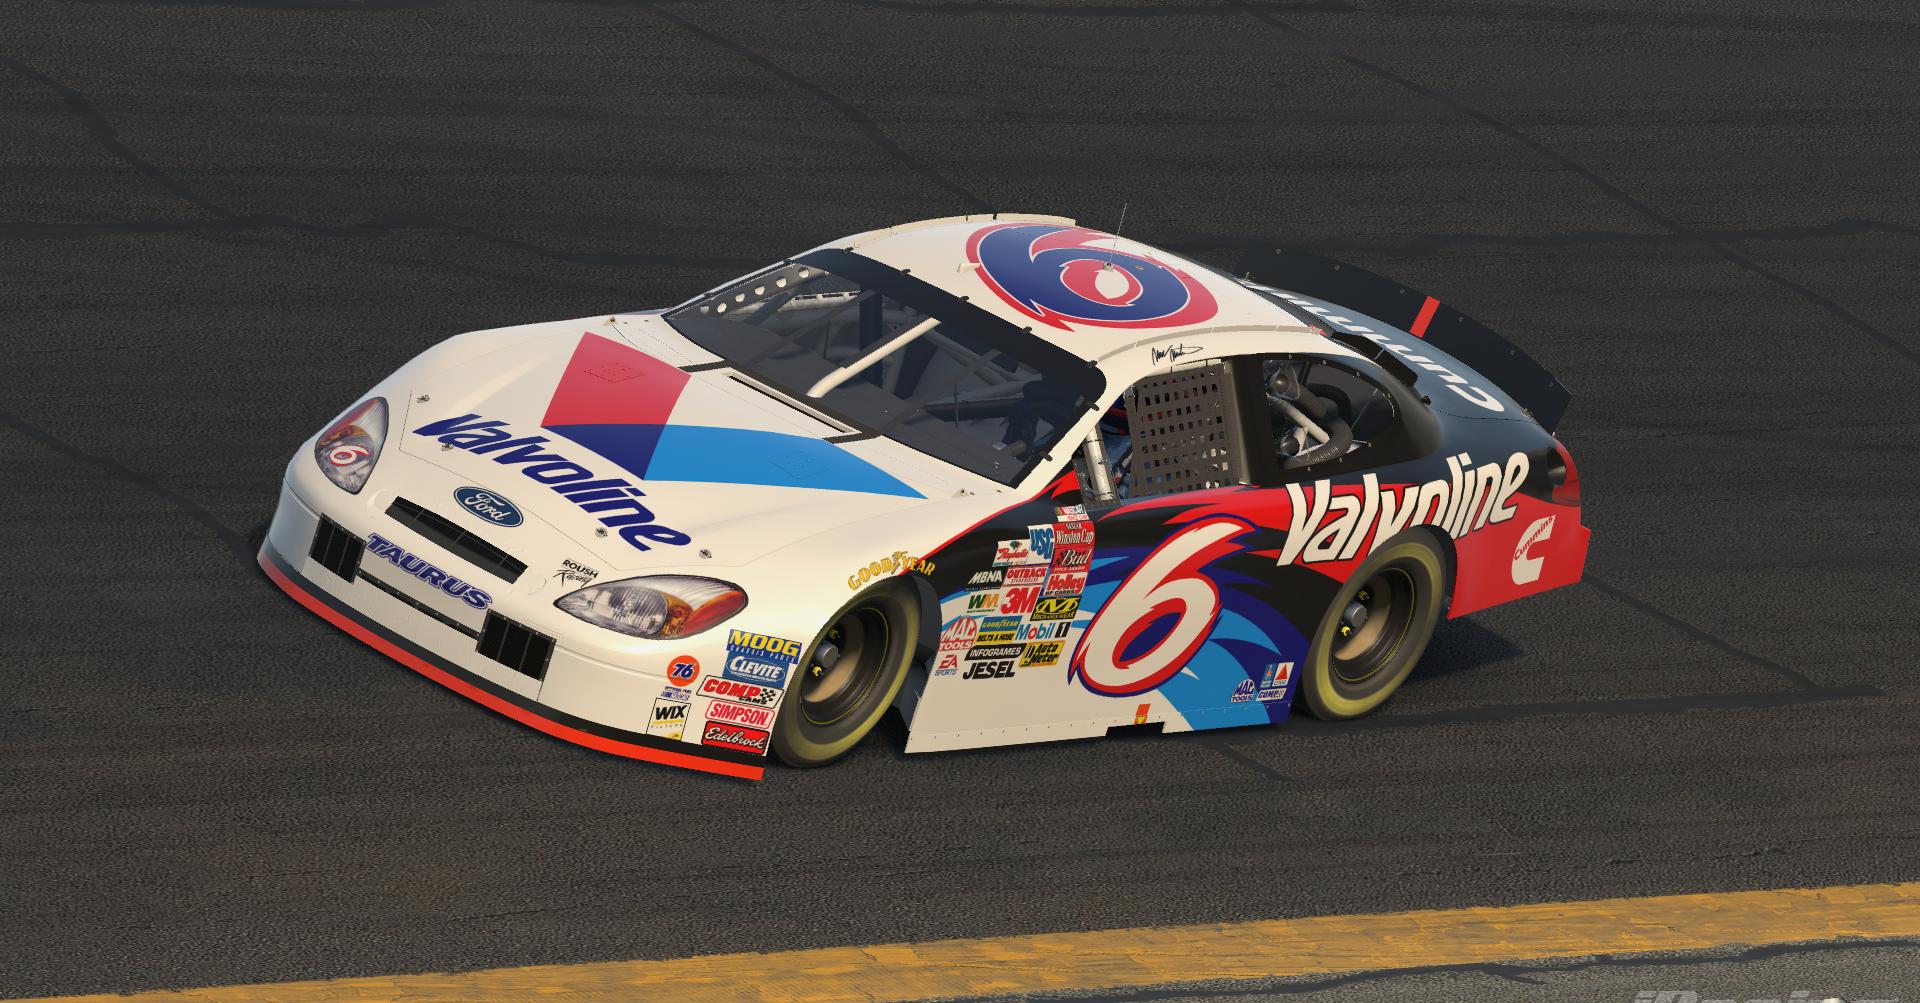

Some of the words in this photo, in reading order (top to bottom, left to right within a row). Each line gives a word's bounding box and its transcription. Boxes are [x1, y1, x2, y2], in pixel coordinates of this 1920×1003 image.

[968, 223, 1205, 328] 6
[329, 444, 369, 466] 6
[412, 414, 691, 551] Valvoline
[465, 491, 511, 525] Ford
[1275, 452, 1530, 567] Valvoline
[1029, 527, 1054, 560] USG
[1081, 528, 1094, 545] Cup
[1514, 517, 1554, 561] Cummins
[1061, 549, 1092, 566] Bud
[366, 533, 492, 609] TAURUS
[562, 559, 599, 578] ROUSH
[848, 551, 936, 591] GOODYEAR
[968, 570, 1003, 584] MBNA
[1007, 567, 1047, 579] OUTBACK
[1046, 573, 1085, 594] Holley
[968, 593, 1000, 609] WM
[1001, 587, 1041, 615] 3M
[1070, 514, 1256, 697] 6
[941, 617, 977, 641] MAC
[999, 632, 1015, 641] HOSE
[1015, 622, 1056, 640] Mobil
[1055, 622, 1072, 638] 1
[729, 630, 800, 657] MOOG
[939, 641, 973, 650] TOOLS
[970, 647, 1022, 657] INFOGRAMES
[1035, 643, 1058, 653] Auto
[730, 656, 782, 678] CLEVITE
[939, 654, 958, 669] EA
[1031, 653, 1059, 664] Meter
[672, 662, 695, 679] 76
[963, 661, 1016, 679] JESEL
[703, 679, 761, 698] COMP
[1258, 689, 1279, 699] COMP
[739, 696, 768, 704] CAMS
[656, 705, 687, 720] WIX
[710, 703, 769, 725] SIMPSON
[705, 727, 765, 749] Edelbrock
